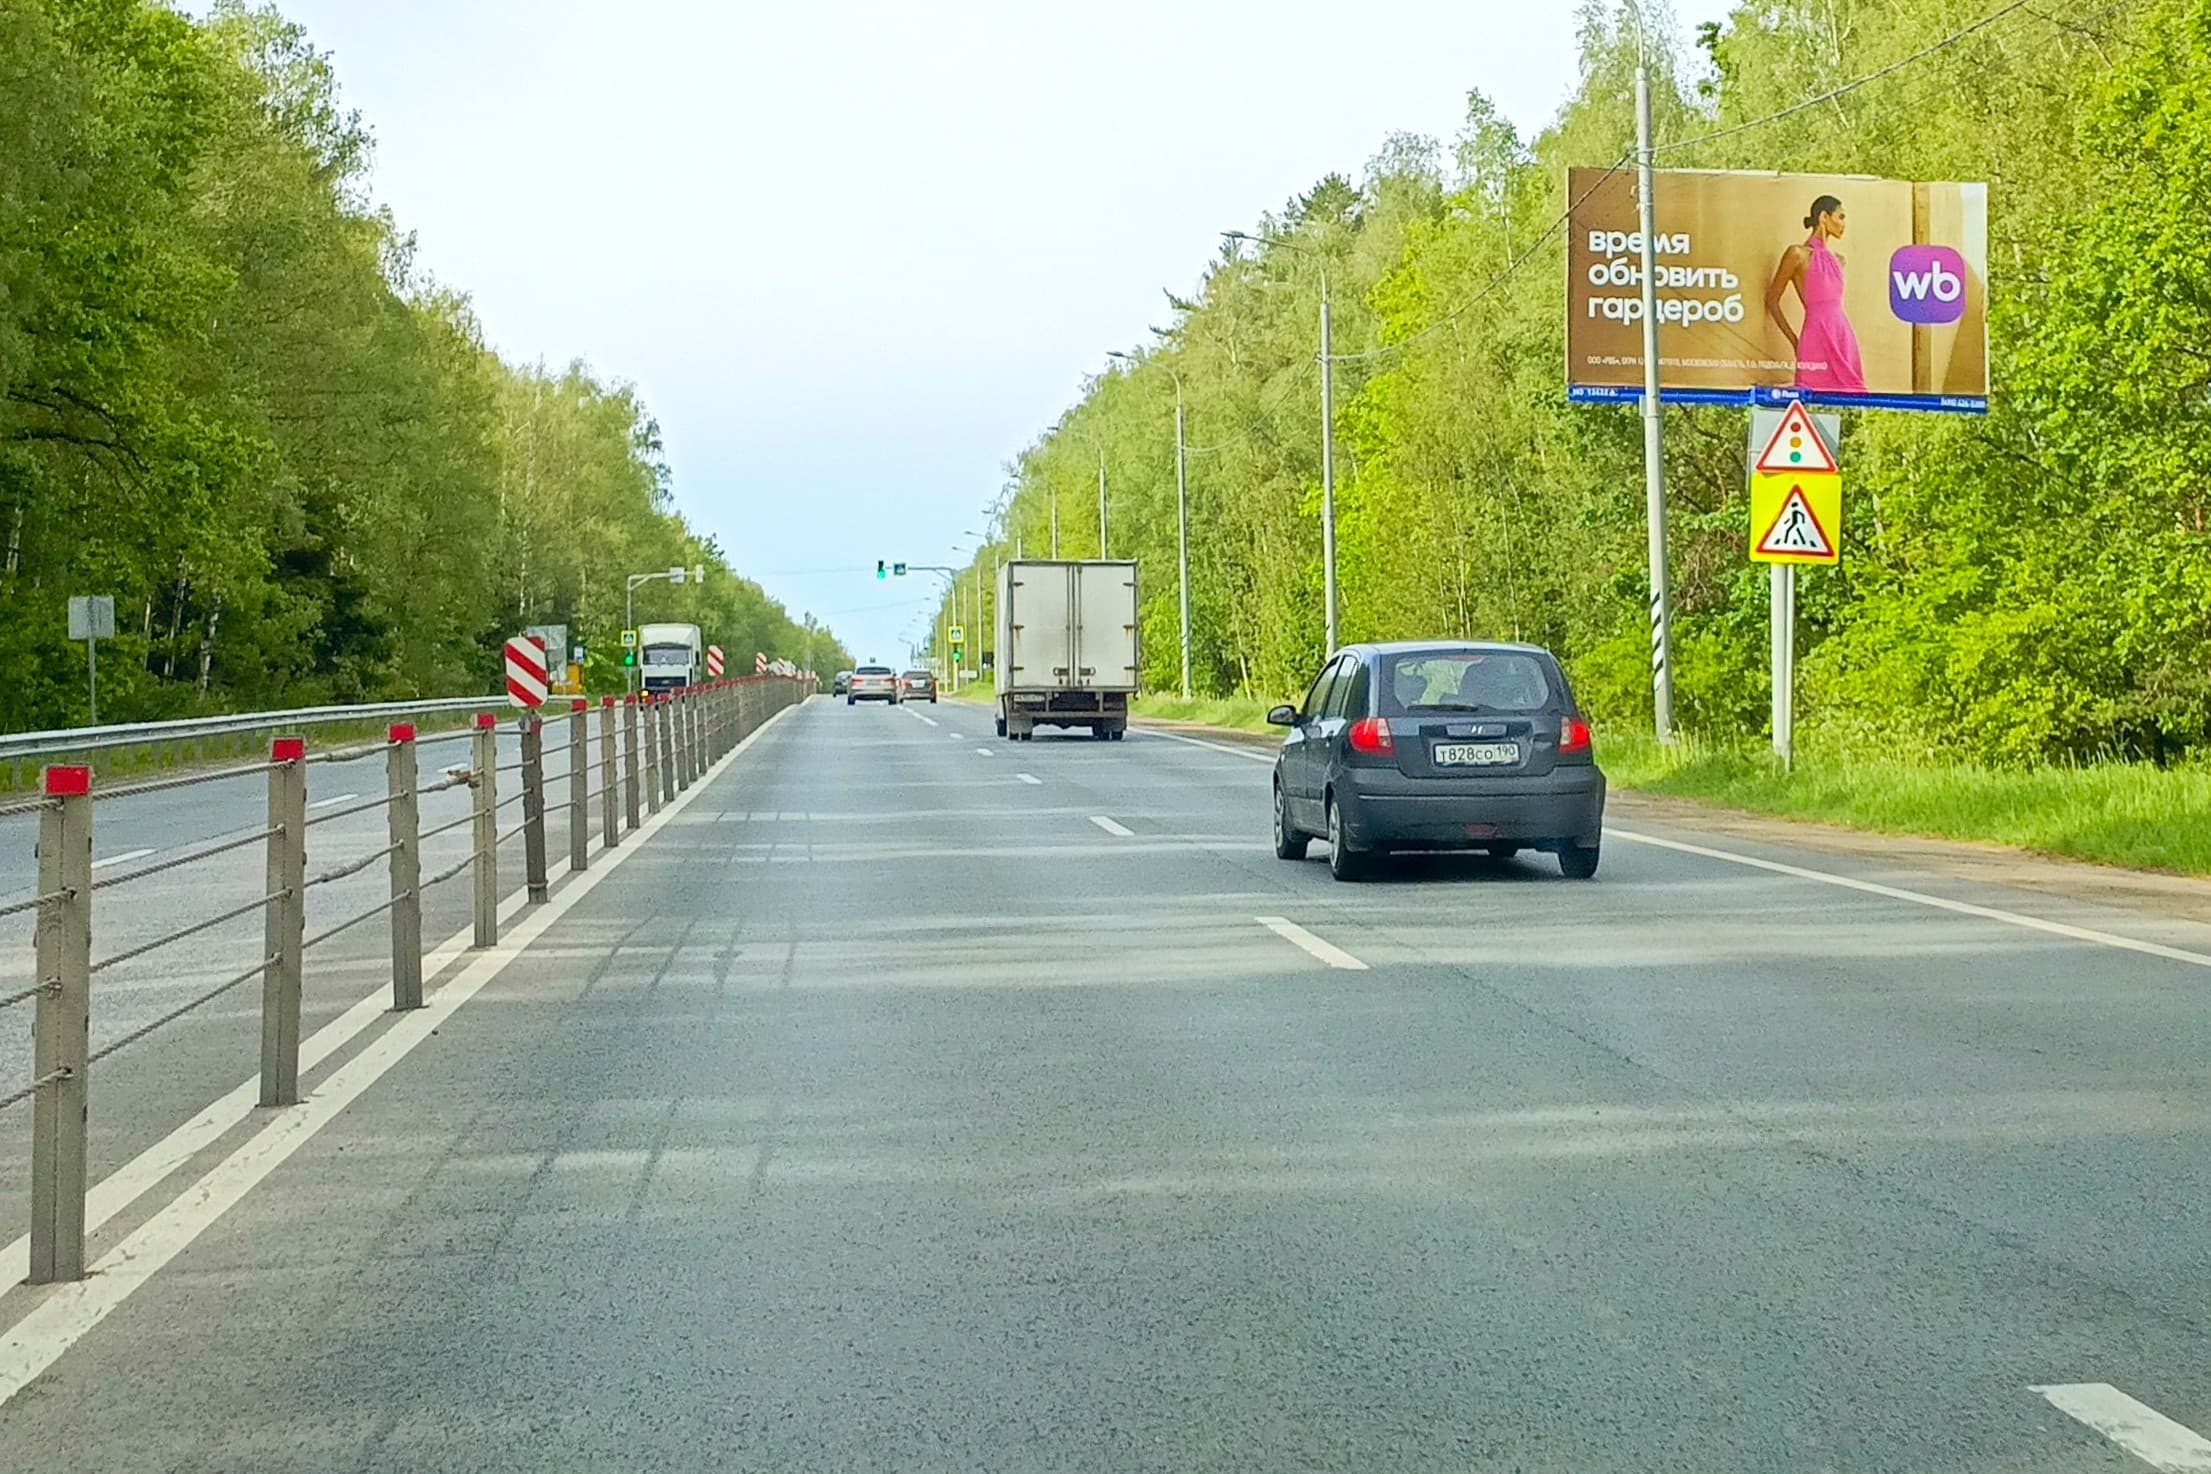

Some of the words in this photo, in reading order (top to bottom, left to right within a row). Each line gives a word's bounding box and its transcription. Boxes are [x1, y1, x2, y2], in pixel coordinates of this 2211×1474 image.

[1588, 230, 1691, 259] время
[1588, 257, 1739, 289] обновить
[1893, 260, 1962, 302] wb
